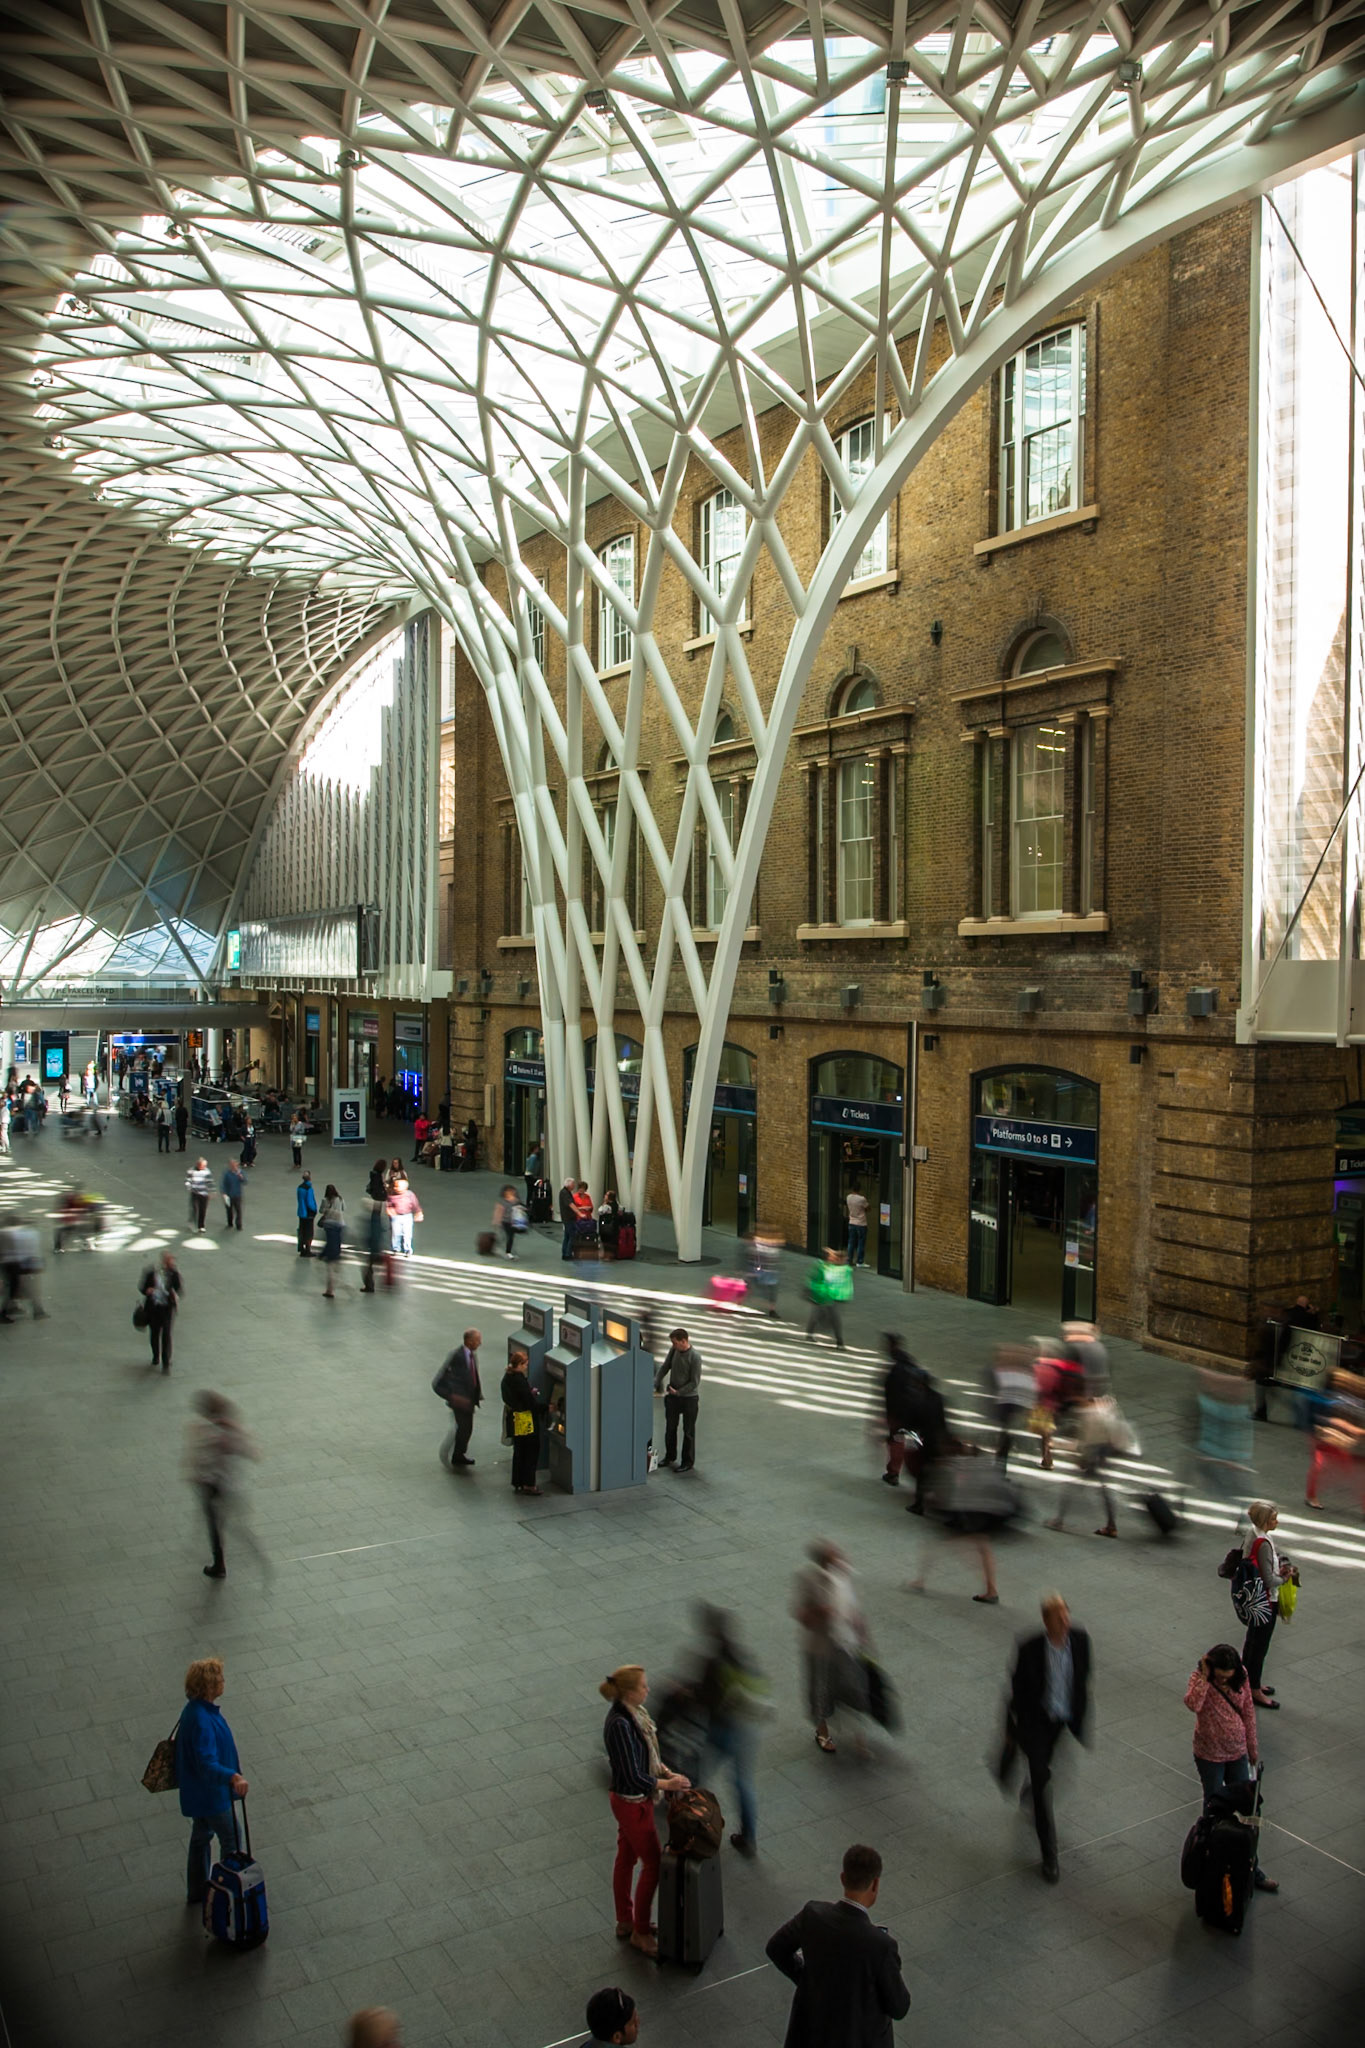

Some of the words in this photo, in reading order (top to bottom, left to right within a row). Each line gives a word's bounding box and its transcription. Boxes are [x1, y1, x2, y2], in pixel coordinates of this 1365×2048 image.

[850, 1109, 870, 1120] Tickets
[993, 1128, 1025, 1142] Platforms
[1026, 1132, 1032, 1143] 0
[1033, 1134, 1041, 1144] to
[1042, 1134, 1048, 1145] 8
